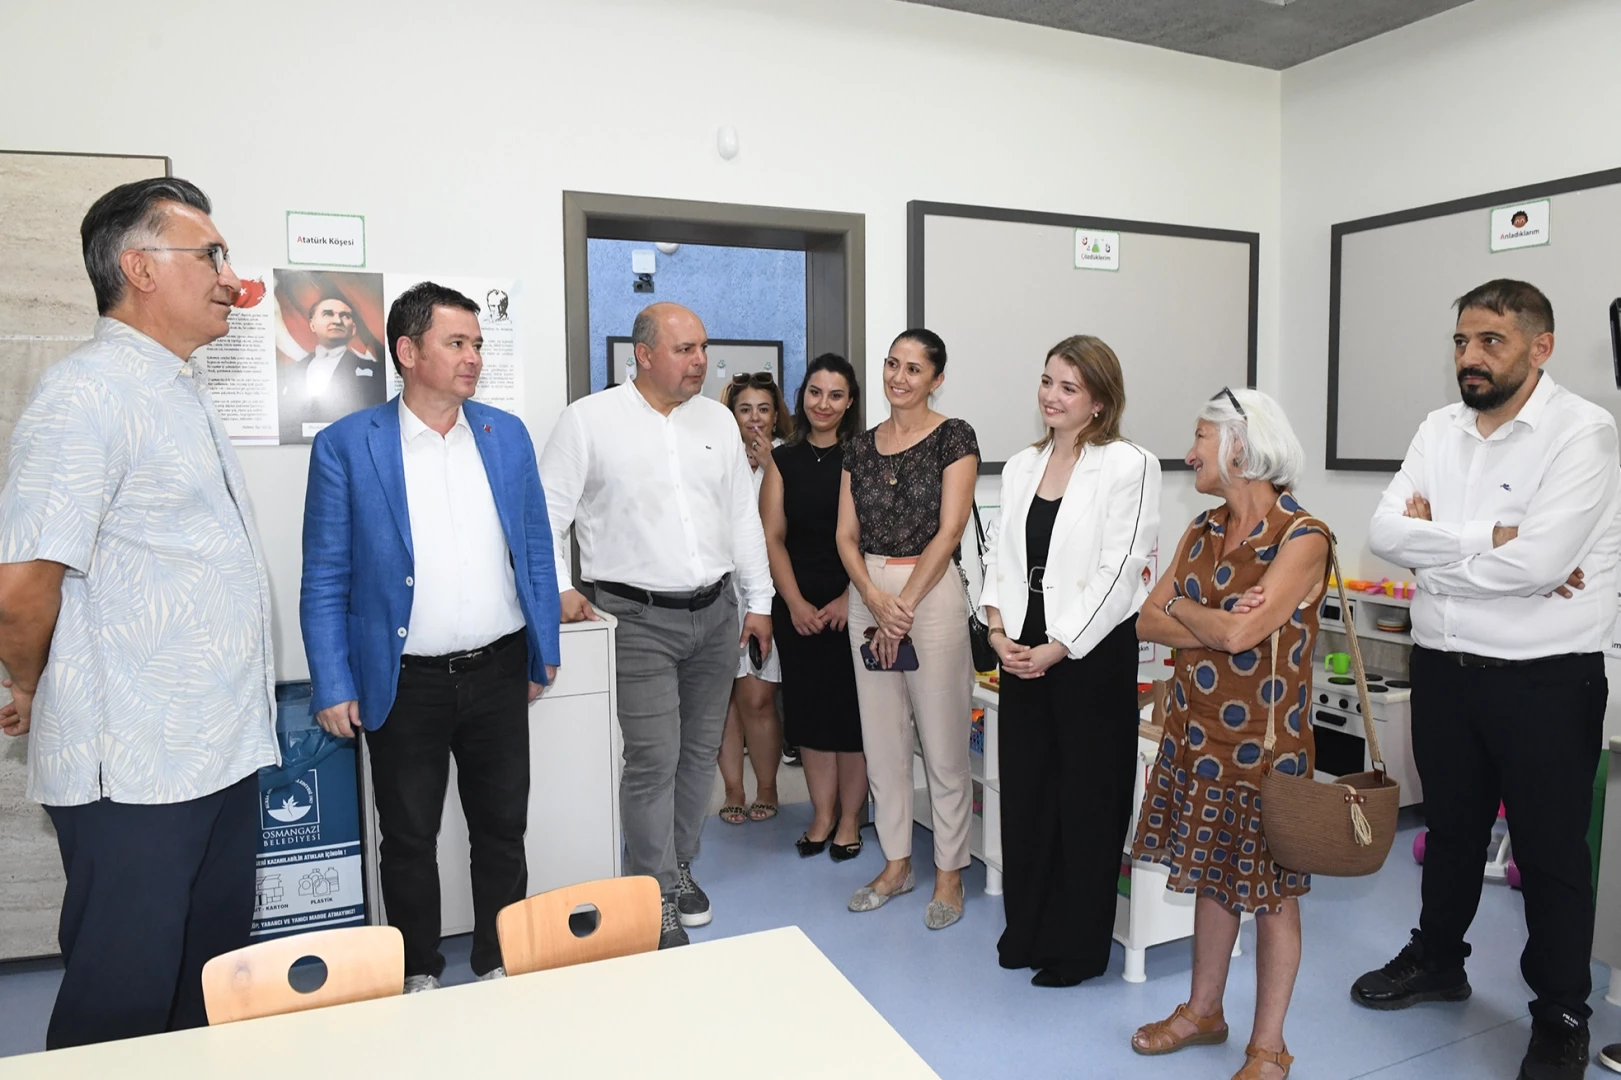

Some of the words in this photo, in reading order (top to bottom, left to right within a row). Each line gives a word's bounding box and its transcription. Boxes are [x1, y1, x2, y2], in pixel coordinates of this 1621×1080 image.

[1500, 229, 1540, 240] Anladıklarım
[297, 235, 328, 245] Atatürk
[329, 237, 354, 247] Köşesi
[262, 824, 320, 839] OSMANGAZİ
[263, 833, 320, 846] BELEDİYESİ
[310, 897, 333, 905] PLASTİK
[265, 903, 289, 911] KARTON
[283, 917, 290, 925] VE
